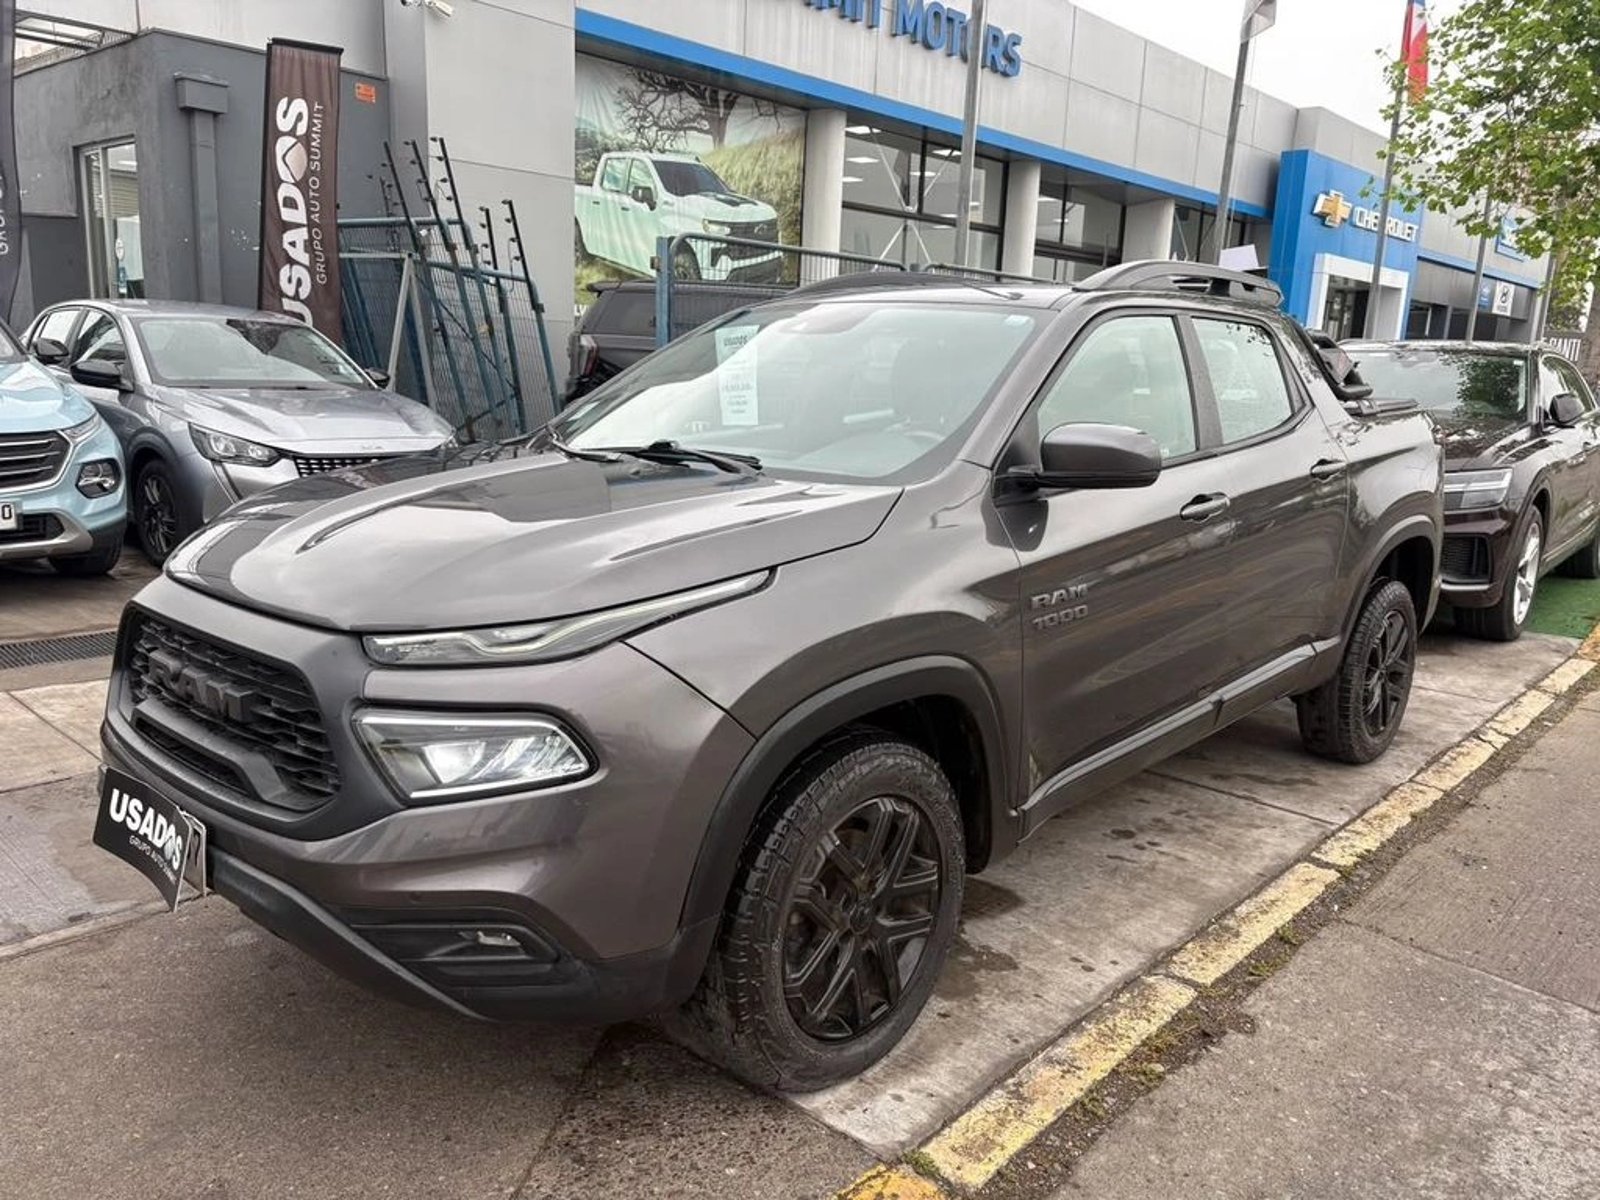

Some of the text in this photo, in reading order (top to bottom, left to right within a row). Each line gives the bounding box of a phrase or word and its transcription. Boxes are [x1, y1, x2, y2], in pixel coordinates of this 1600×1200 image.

[0, 187, 9, 256] GRU
[275, 97, 313, 327] USADOS
[308, 102, 327, 285] GRUPO AUTO SUMMIT
[1354, 207, 1419, 242] CHEROLET
[1031, 583, 1088, 609] RAM
[1032, 605, 1088, 630] 1000
[148, 648, 256, 721] RAM
[109, 787, 184, 871] USADOS
